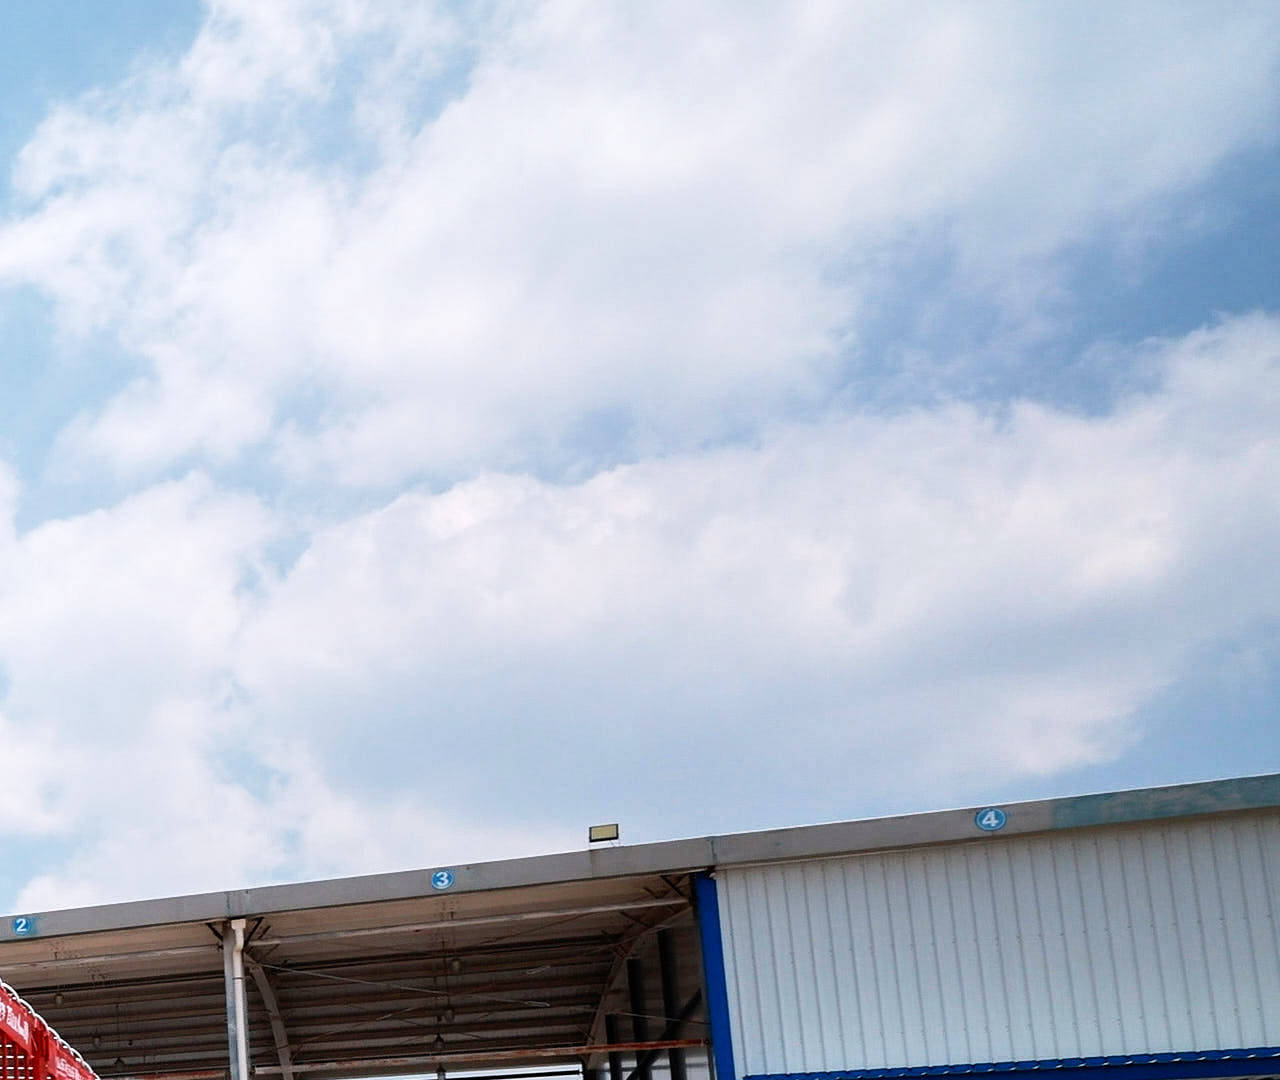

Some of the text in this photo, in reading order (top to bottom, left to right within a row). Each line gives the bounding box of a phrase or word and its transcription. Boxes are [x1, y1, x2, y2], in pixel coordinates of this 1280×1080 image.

[982, 811, 998, 827] 4
[437, 872, 449, 887] 3
[16, 918, 27, 932] 2
